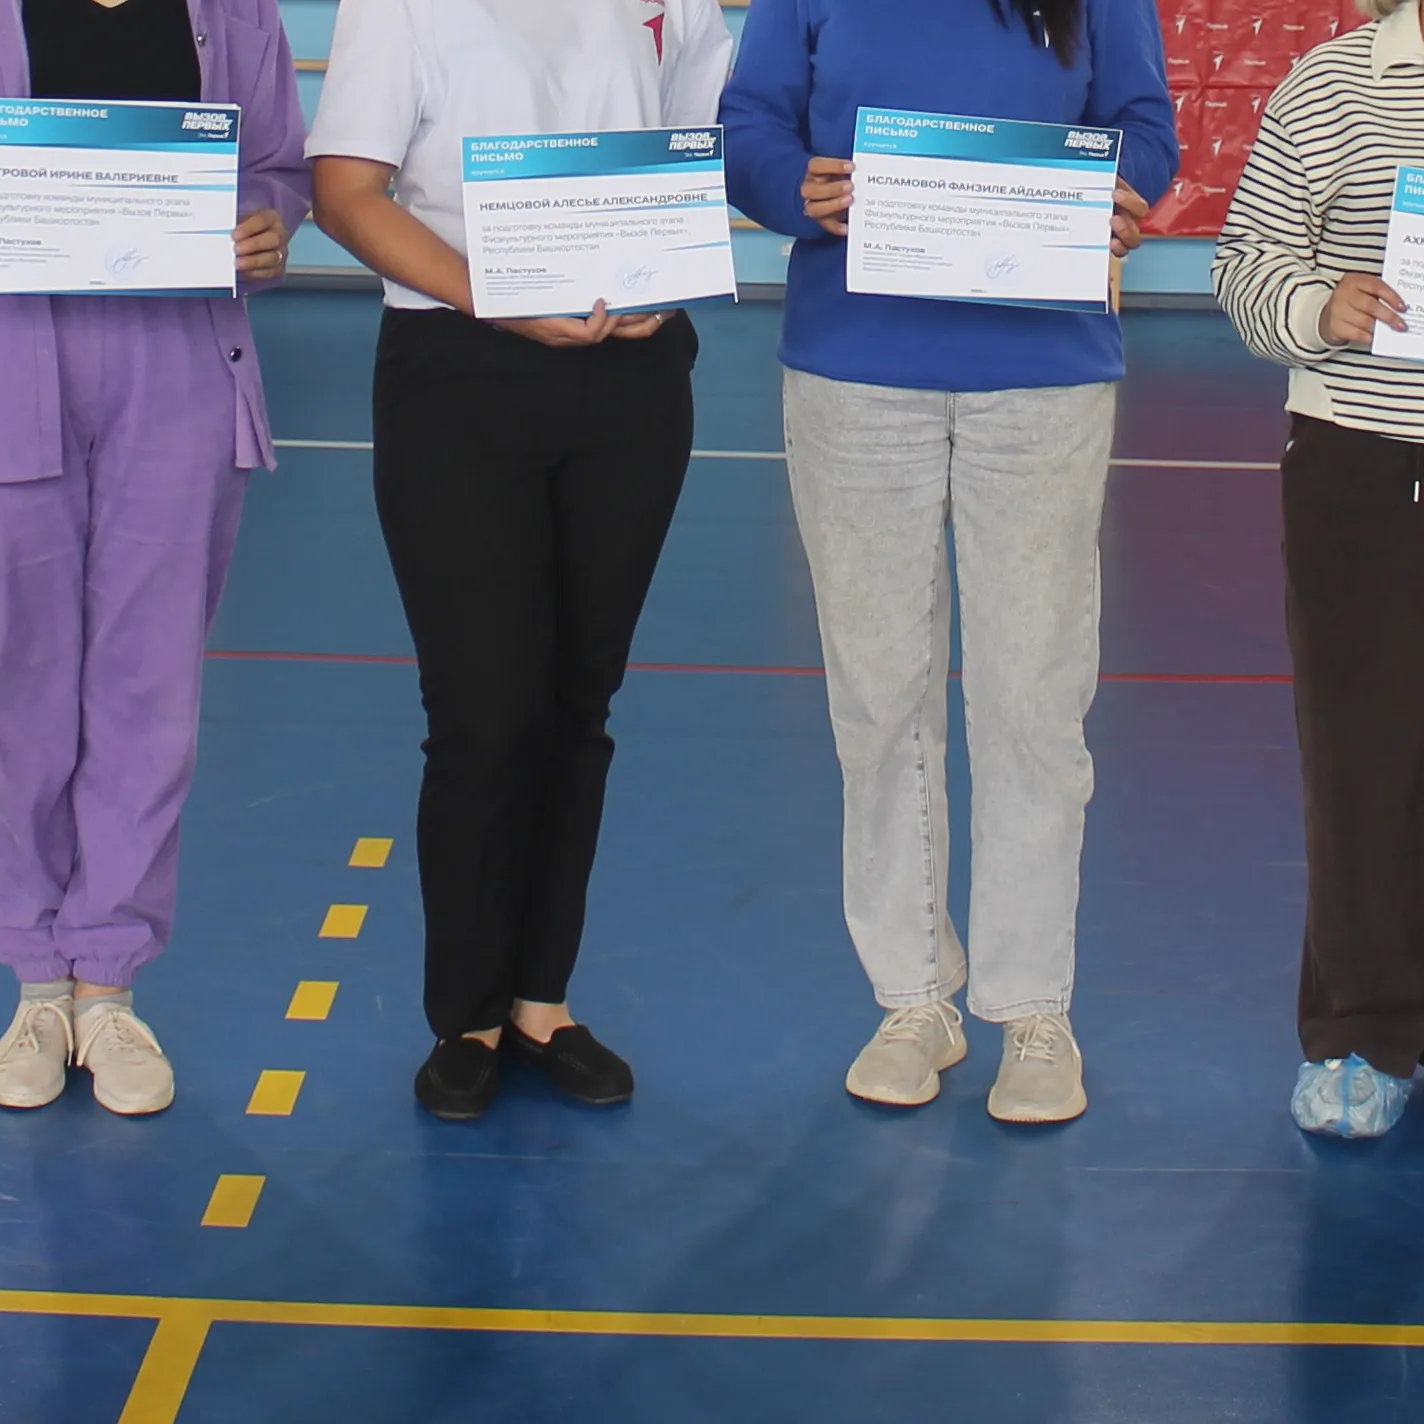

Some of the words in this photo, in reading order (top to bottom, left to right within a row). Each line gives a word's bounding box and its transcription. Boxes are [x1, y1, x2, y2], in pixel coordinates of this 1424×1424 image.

[184, 111, 226, 121] ВЫЗОВ
[182, 119, 231, 131] ПЕРВЫХ
[866, 113, 995, 134] БЛАГОДАРСТВЕННОЕ
[670, 131, 712, 141] ВЫЗОВ
[864, 125, 918, 138] ПИСЬМО
[1067, 130, 1109, 142] ВЫЗОВ
[470, 137, 599, 152] БЛАГОДАРСТВЕННОЕ
[668, 137, 716, 150] ПЕРВЫХ
[1064, 138, 1113, 151] ПЕРВЫХ
[470, 152, 524, 163] ПИСЬМО
[49, 170, 92, 180] ИРИНЕ
[95, 172, 179, 183] ВАЛЕРИЕВНЕ
[867, 174, 945, 189] ИСЛАМОВОЙ
[947, 180, 1007, 195] ФАНЗИЛЕ
[1009, 185, 1083, 201] АЙДАРОВНЕ
[479, 196, 550, 212] НЕМЦОВОЙ
[552, 197, 599, 208] АЛЕСЬЕ
[601, 192, 708, 206] АЛЕКСАНДРОВНЕ
